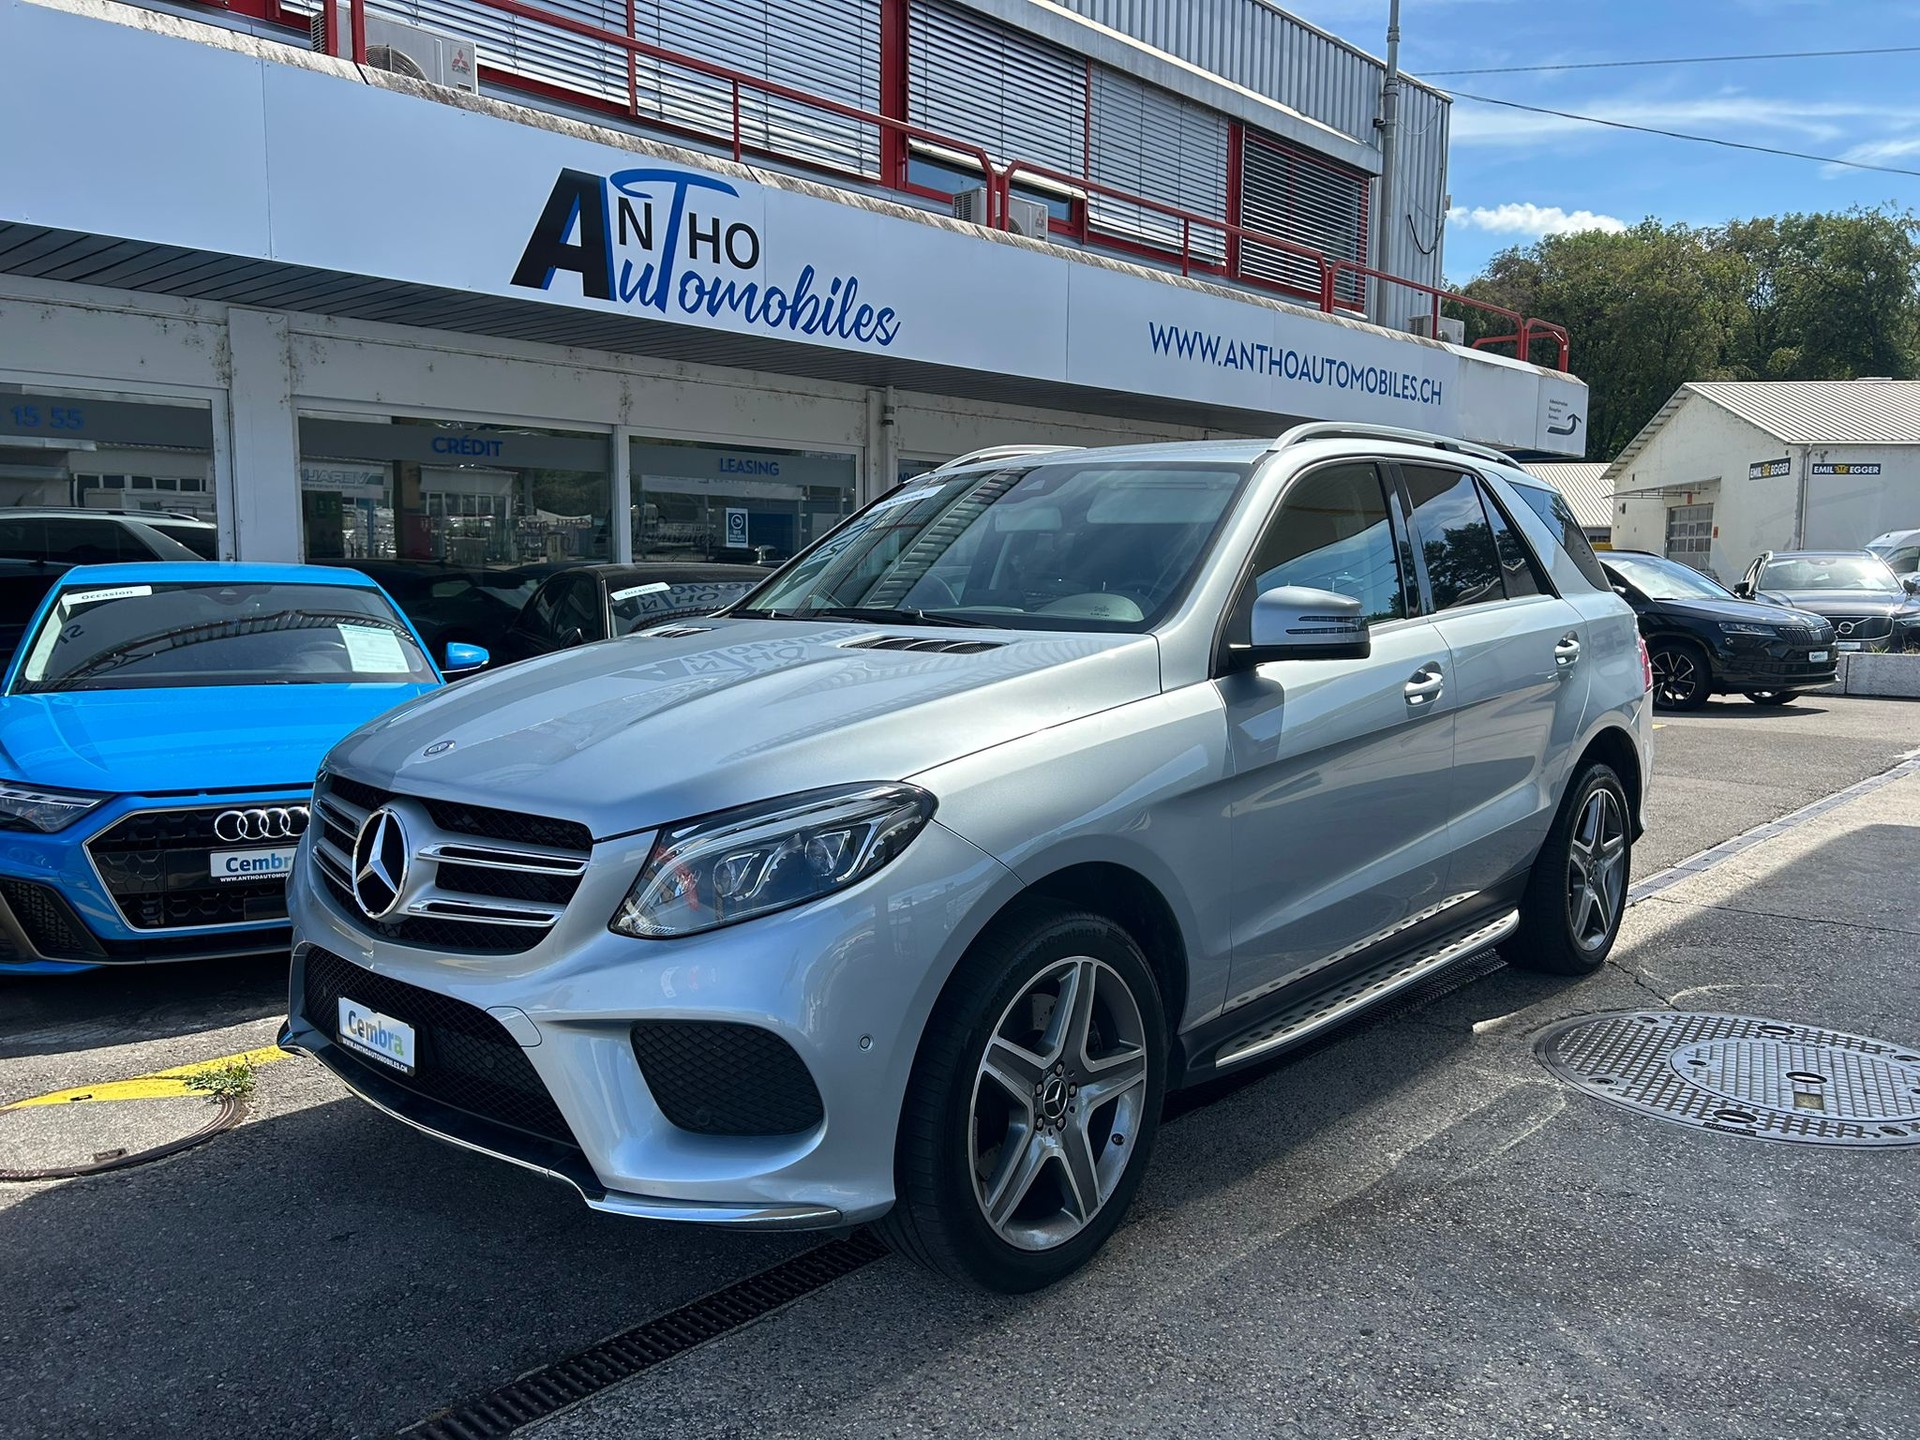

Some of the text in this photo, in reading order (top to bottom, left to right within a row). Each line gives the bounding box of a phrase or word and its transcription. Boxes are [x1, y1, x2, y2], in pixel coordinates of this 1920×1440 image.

[511, 168, 760, 302] ANTHO
[1149, 321, 1442, 406] WWW.ANTHOAUTOMOBILES.CH
[11, 404, 85, 430] 15 55
[432, 435, 504, 457] CRÉDIT
[720, 457, 780, 477] LEASING
[1750, 462, 1789, 478] EMIL EGGER
[1813, 466, 1879, 474] EMIL EGGER
[81, 590, 133, 600] Occasion
[225, 853, 292, 873] Cembr
[348, 1010, 404, 1056] Cembra
